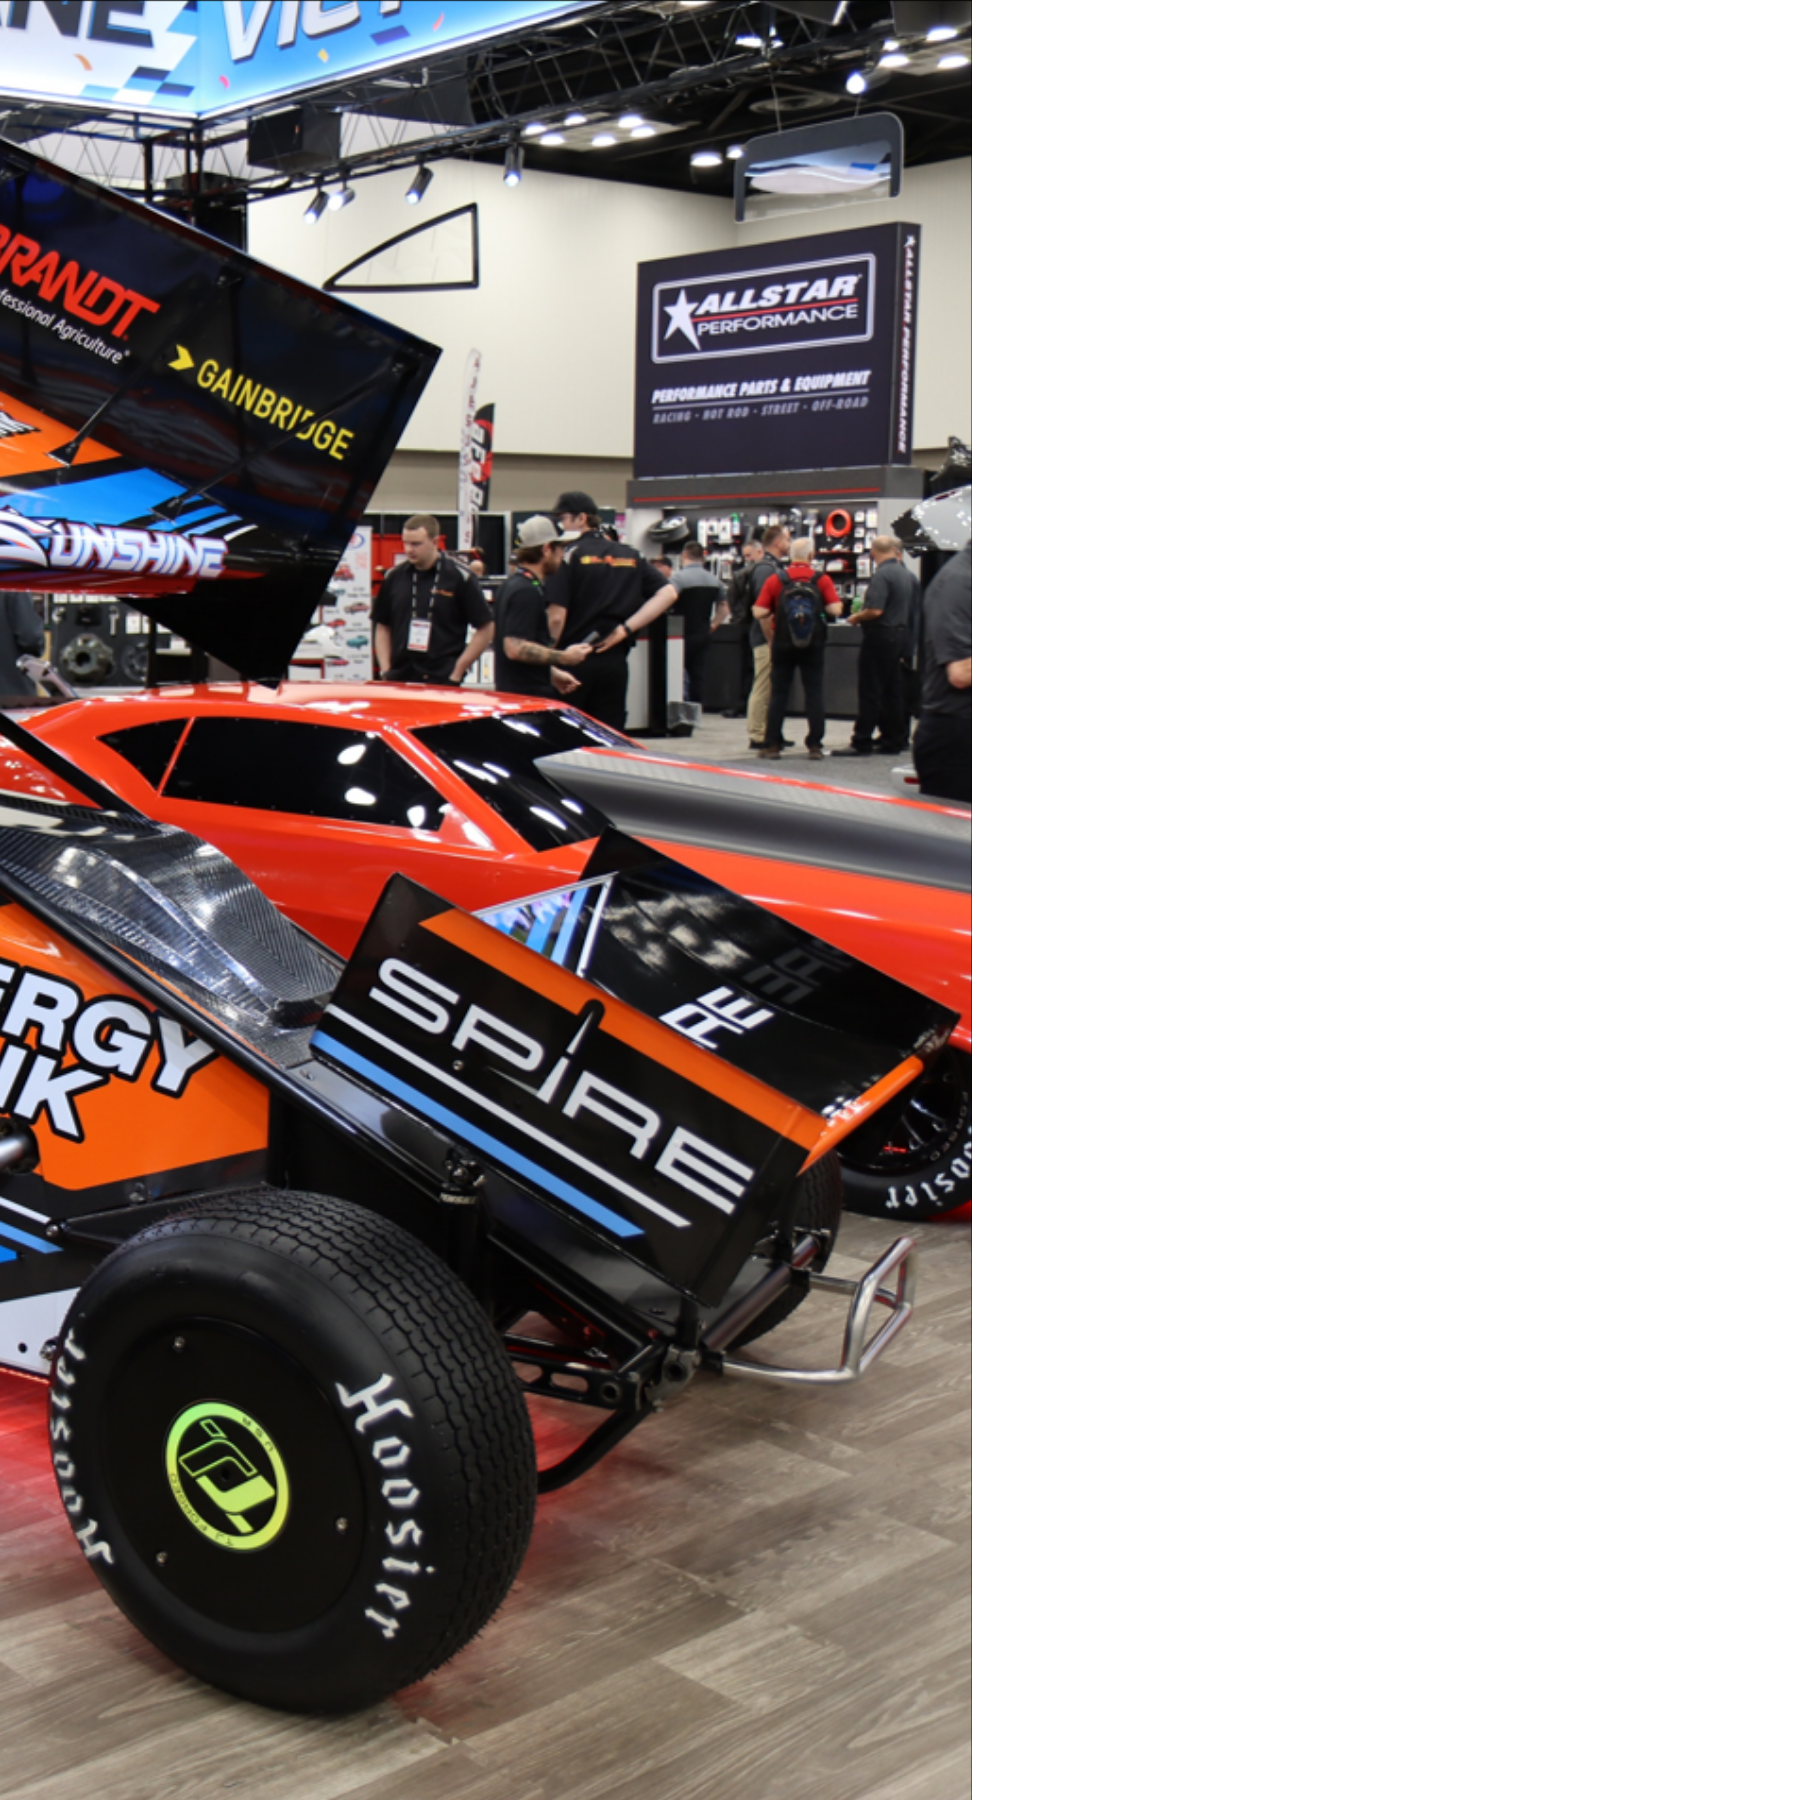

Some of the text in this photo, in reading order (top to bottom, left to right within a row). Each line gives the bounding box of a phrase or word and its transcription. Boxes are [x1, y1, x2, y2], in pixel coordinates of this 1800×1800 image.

[695, 274, 860, 315] ALLSTAR
[696, 304, 859, 336] PERFORMANCE
[196, 358, 355, 462] GAINBRIDGE
[651, 369, 872, 404] PERFORMANCE PARTS & EQUIPMENT
[652, 396, 869, 425] RACING HOT ROD STREET OFF-ROAD
[369, 957, 754, 1215] SPIRE
[49, 1328, 114, 1566] Hoosier
[335, 1373, 436, 1640] Hoosier
